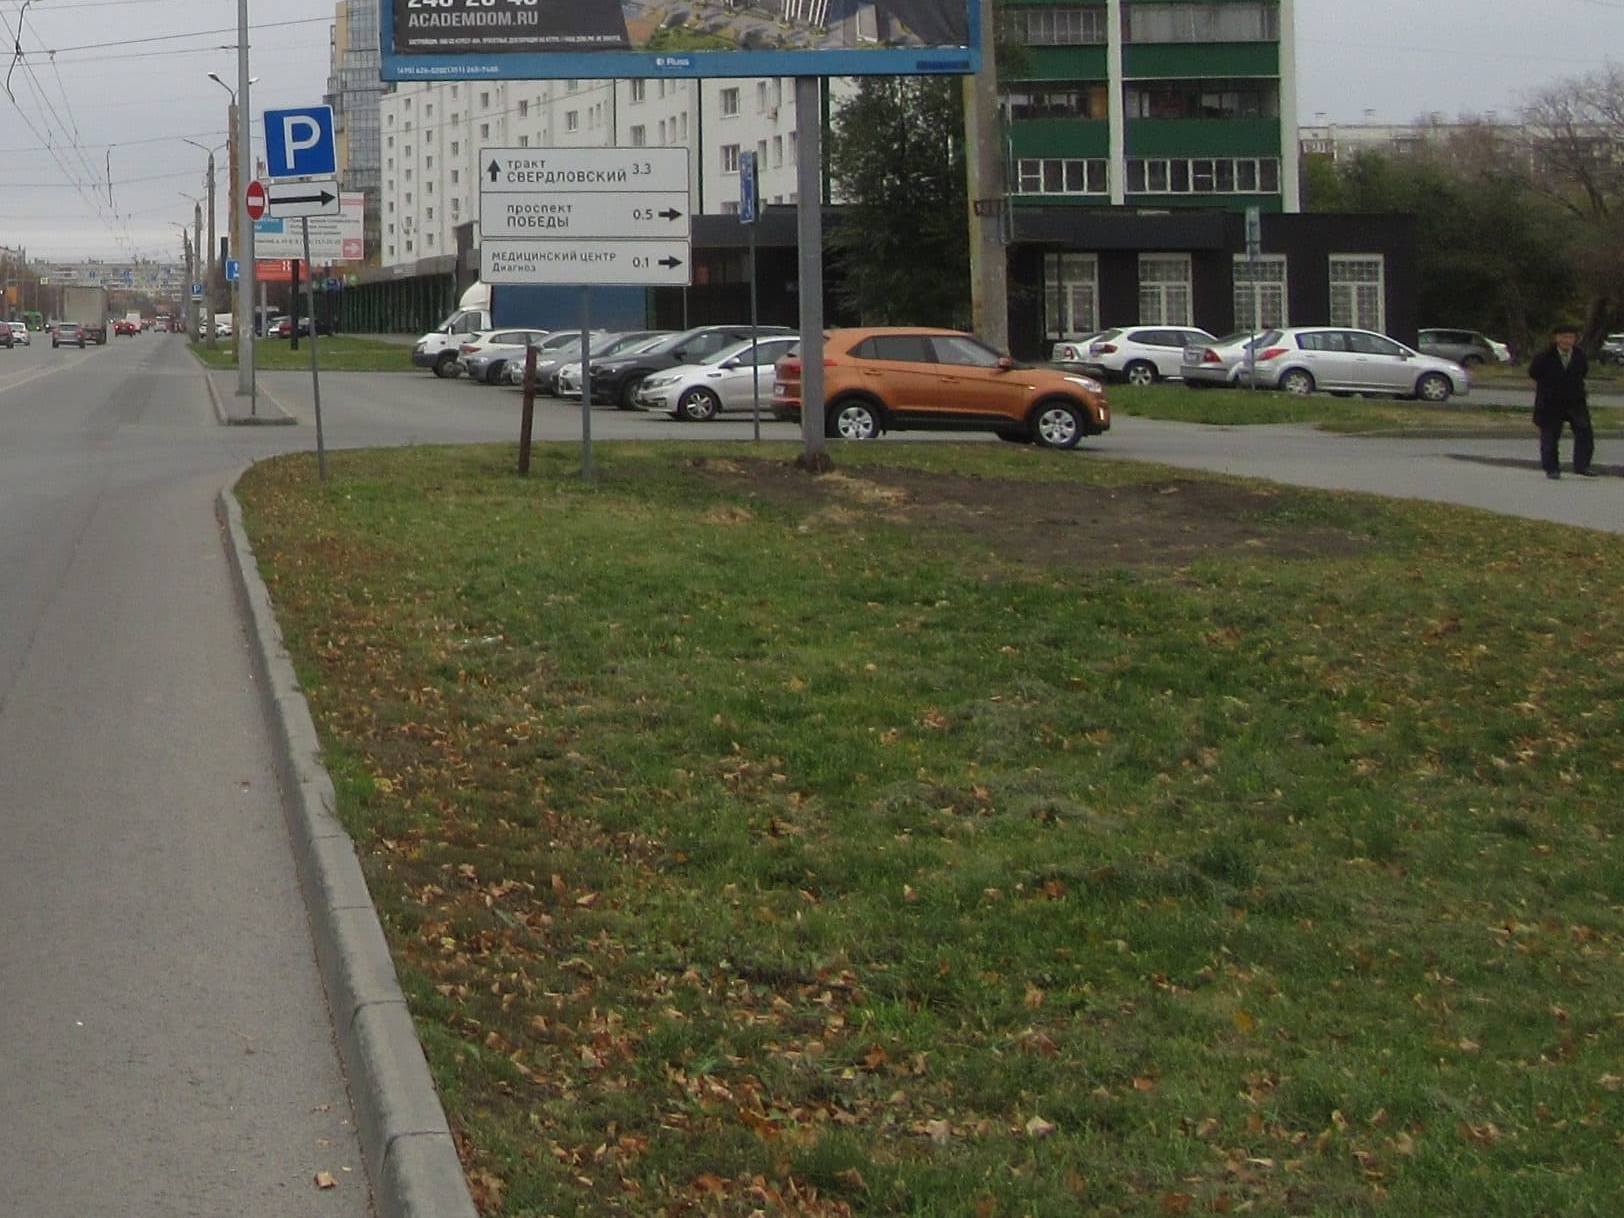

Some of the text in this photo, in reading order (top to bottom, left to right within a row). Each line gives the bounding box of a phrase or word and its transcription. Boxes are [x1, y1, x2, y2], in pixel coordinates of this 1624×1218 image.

[408, 10, 539, 28] ACADEMDOM.RU
[507, 159, 546, 170] тракт
[632, 163, 652, 175] 3.3
[507, 168, 626, 184] СВЕРДЛОВСКИЙ
[507, 204, 574, 215] проспект
[633, 209, 653, 220] 0.5
[507, 215, 569, 229] ПОБЕДЫ
[492, 250, 617, 263] МЕДИЦИНСКИЙ ЦЕНТР
[633, 256, 649, 268] 0.1
[492, 262, 536, 272] Диагноз
